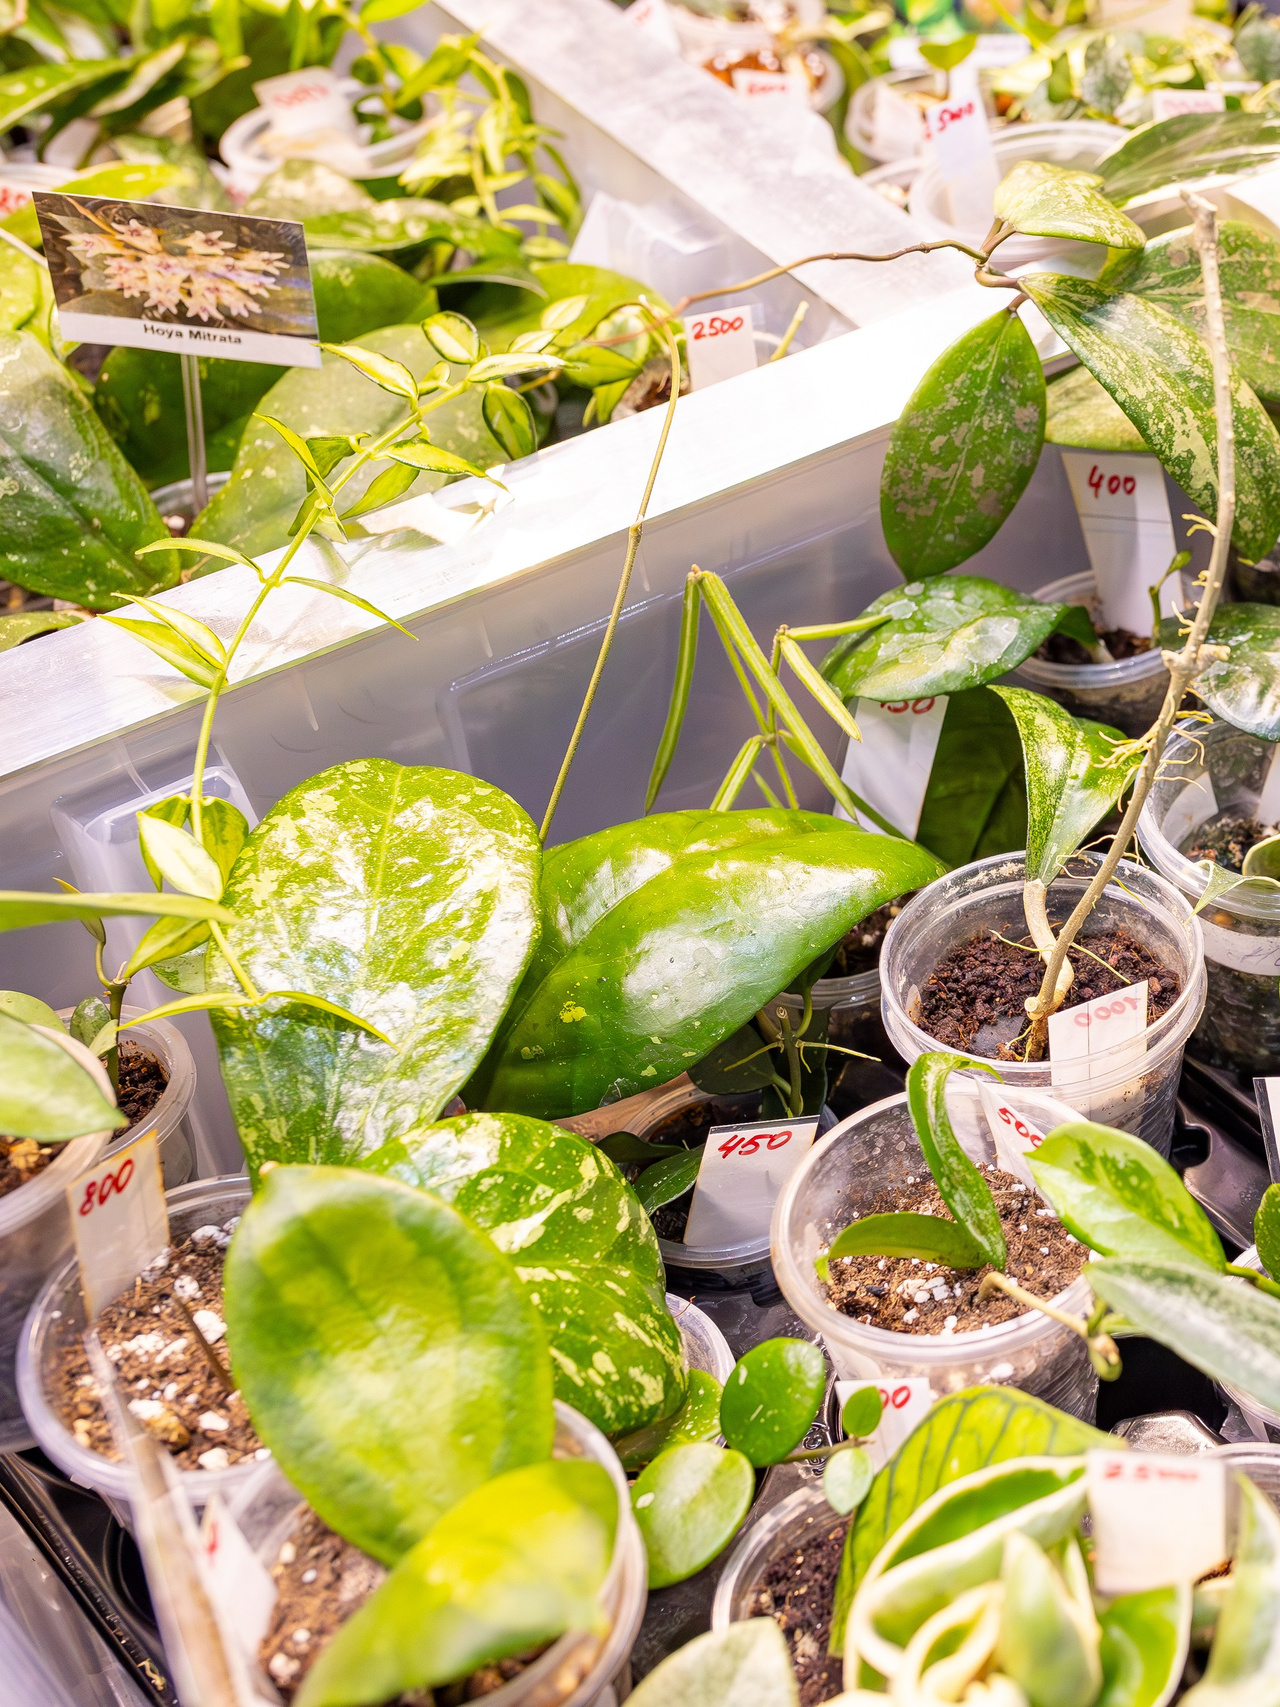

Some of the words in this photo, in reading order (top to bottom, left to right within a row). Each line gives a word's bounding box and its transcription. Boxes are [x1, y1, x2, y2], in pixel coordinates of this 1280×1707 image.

[143, 323, 183, 338] Hoya
[189, 329, 242, 344] Mitrata
[692, 317, 744, 340] 2500
[1088, 465, 1136, 499] 400
[997, 1107, 1044, 1149] 500
[717, 1130, 793, 1159] 450
[79, 1158, 135, 1217] 800
